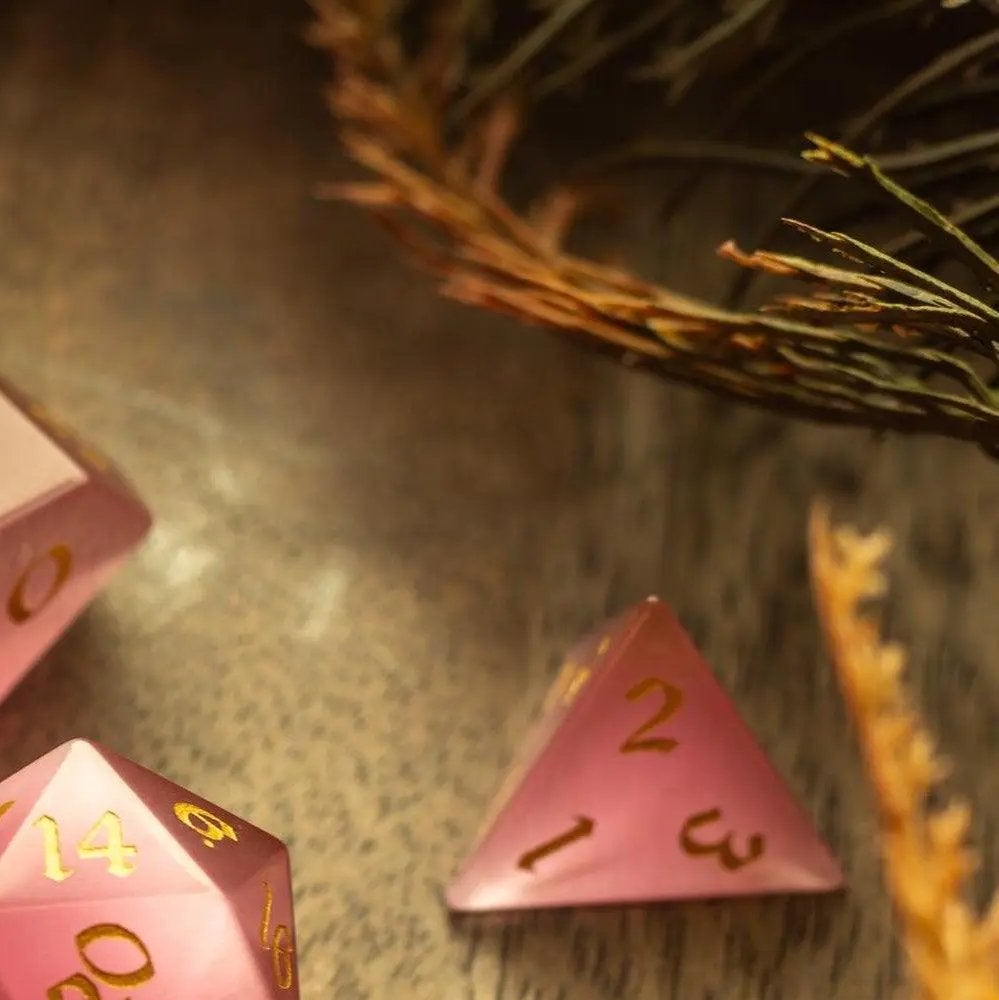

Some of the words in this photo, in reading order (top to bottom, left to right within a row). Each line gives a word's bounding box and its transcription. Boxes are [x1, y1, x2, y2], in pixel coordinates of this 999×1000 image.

[7, 545, 73, 625] 0
[620, 677, 683, 754] 2
[31, 811, 138, 883] 14
[517, 815, 595, 872] 1
[679, 808, 765, 872] 3
